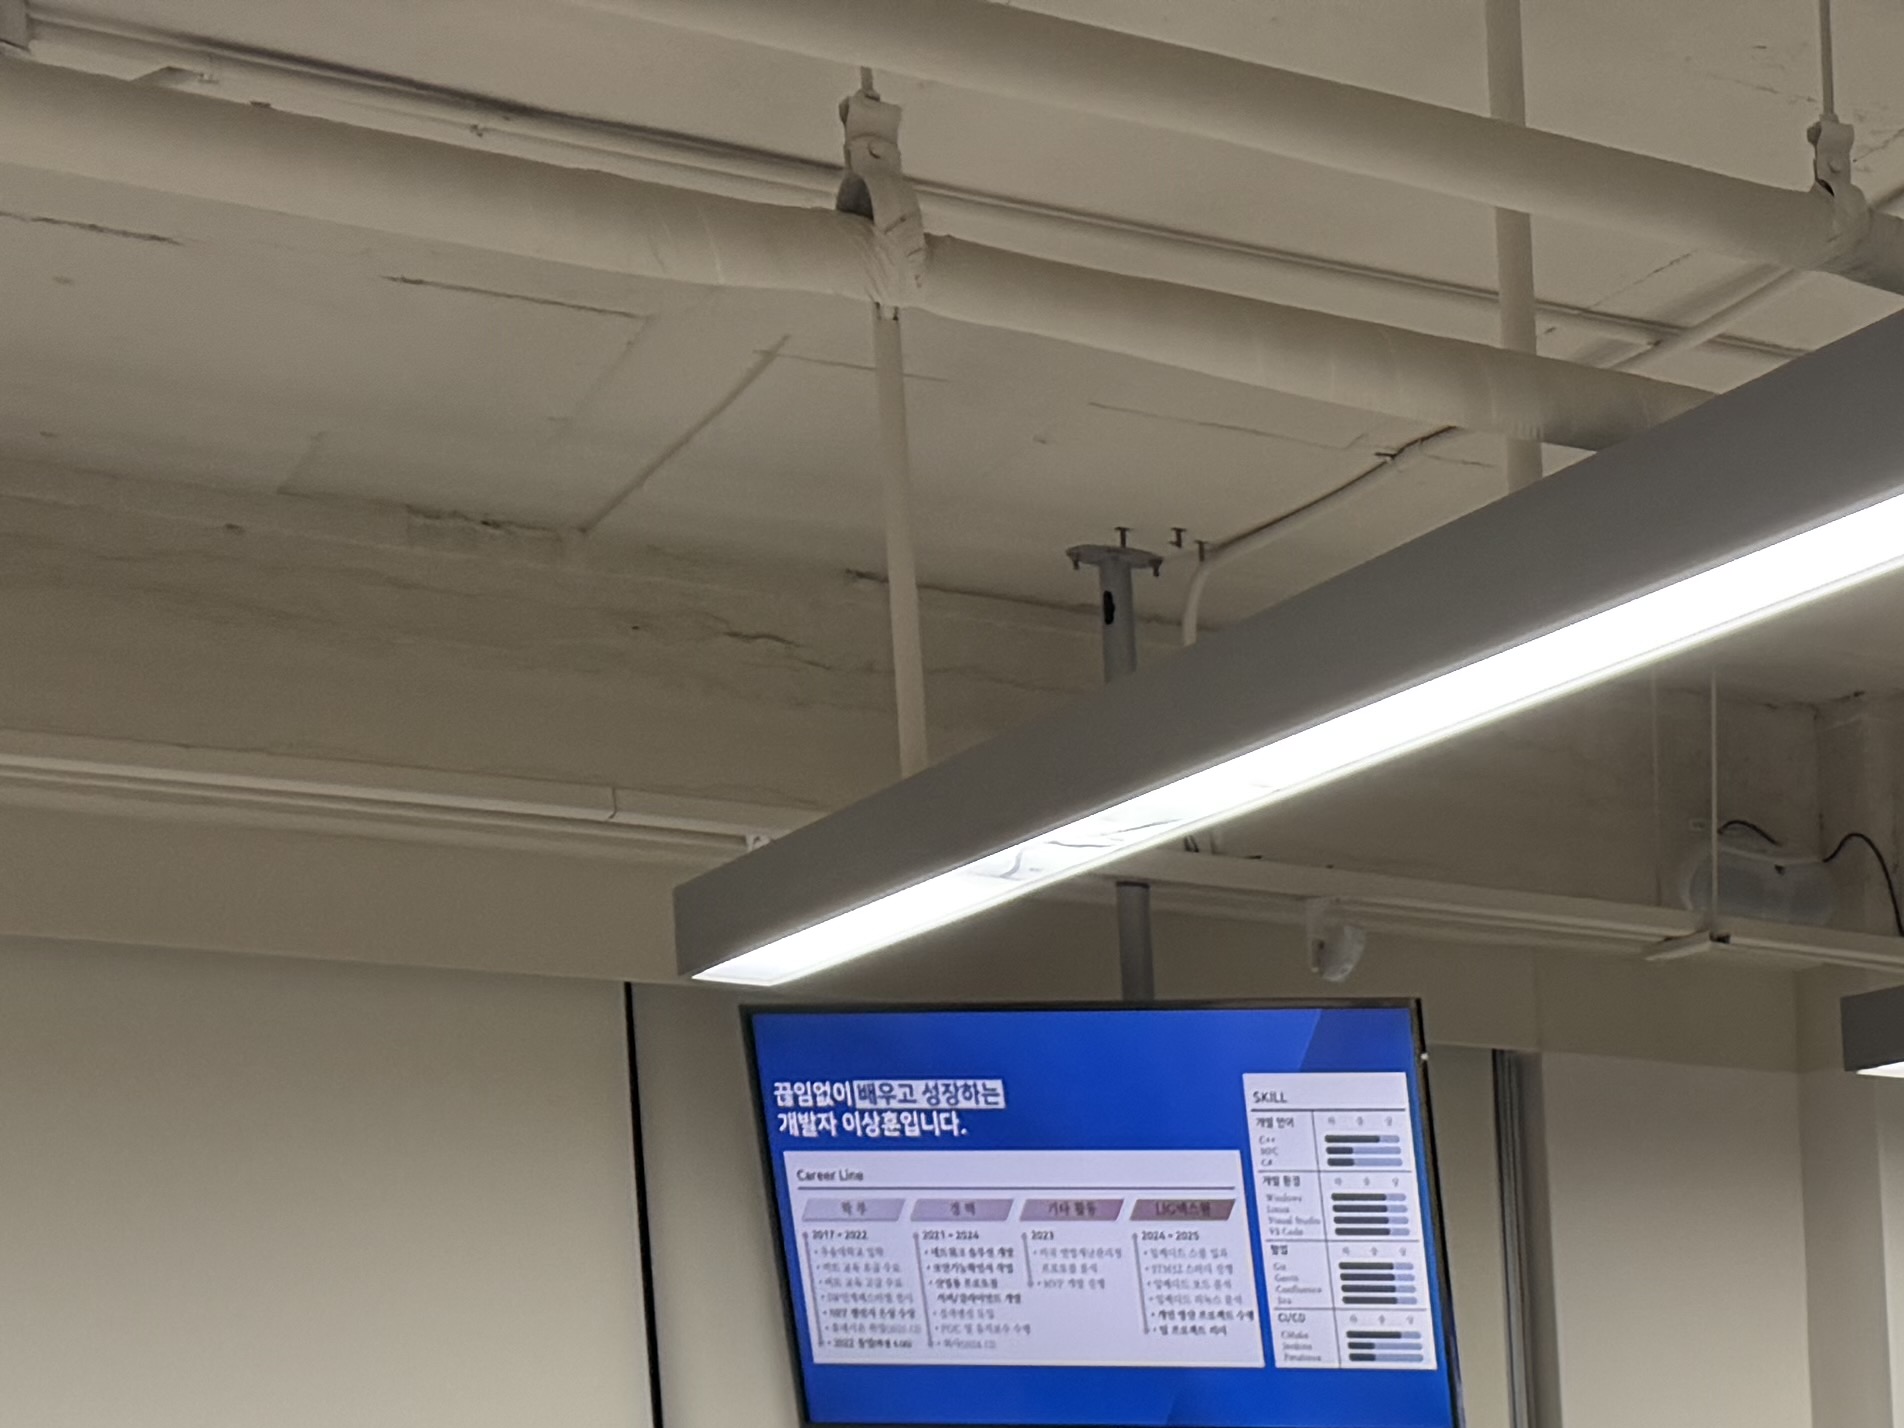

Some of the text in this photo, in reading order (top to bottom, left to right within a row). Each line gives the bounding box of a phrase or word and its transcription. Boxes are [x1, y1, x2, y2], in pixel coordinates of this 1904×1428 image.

[774, 1081, 851, 1107] 끊임없이
[857, 1082, 1000, 1106] 배우고 성장하는
[778, 1111, 967, 1137] 개발자 이상훈입니다.
